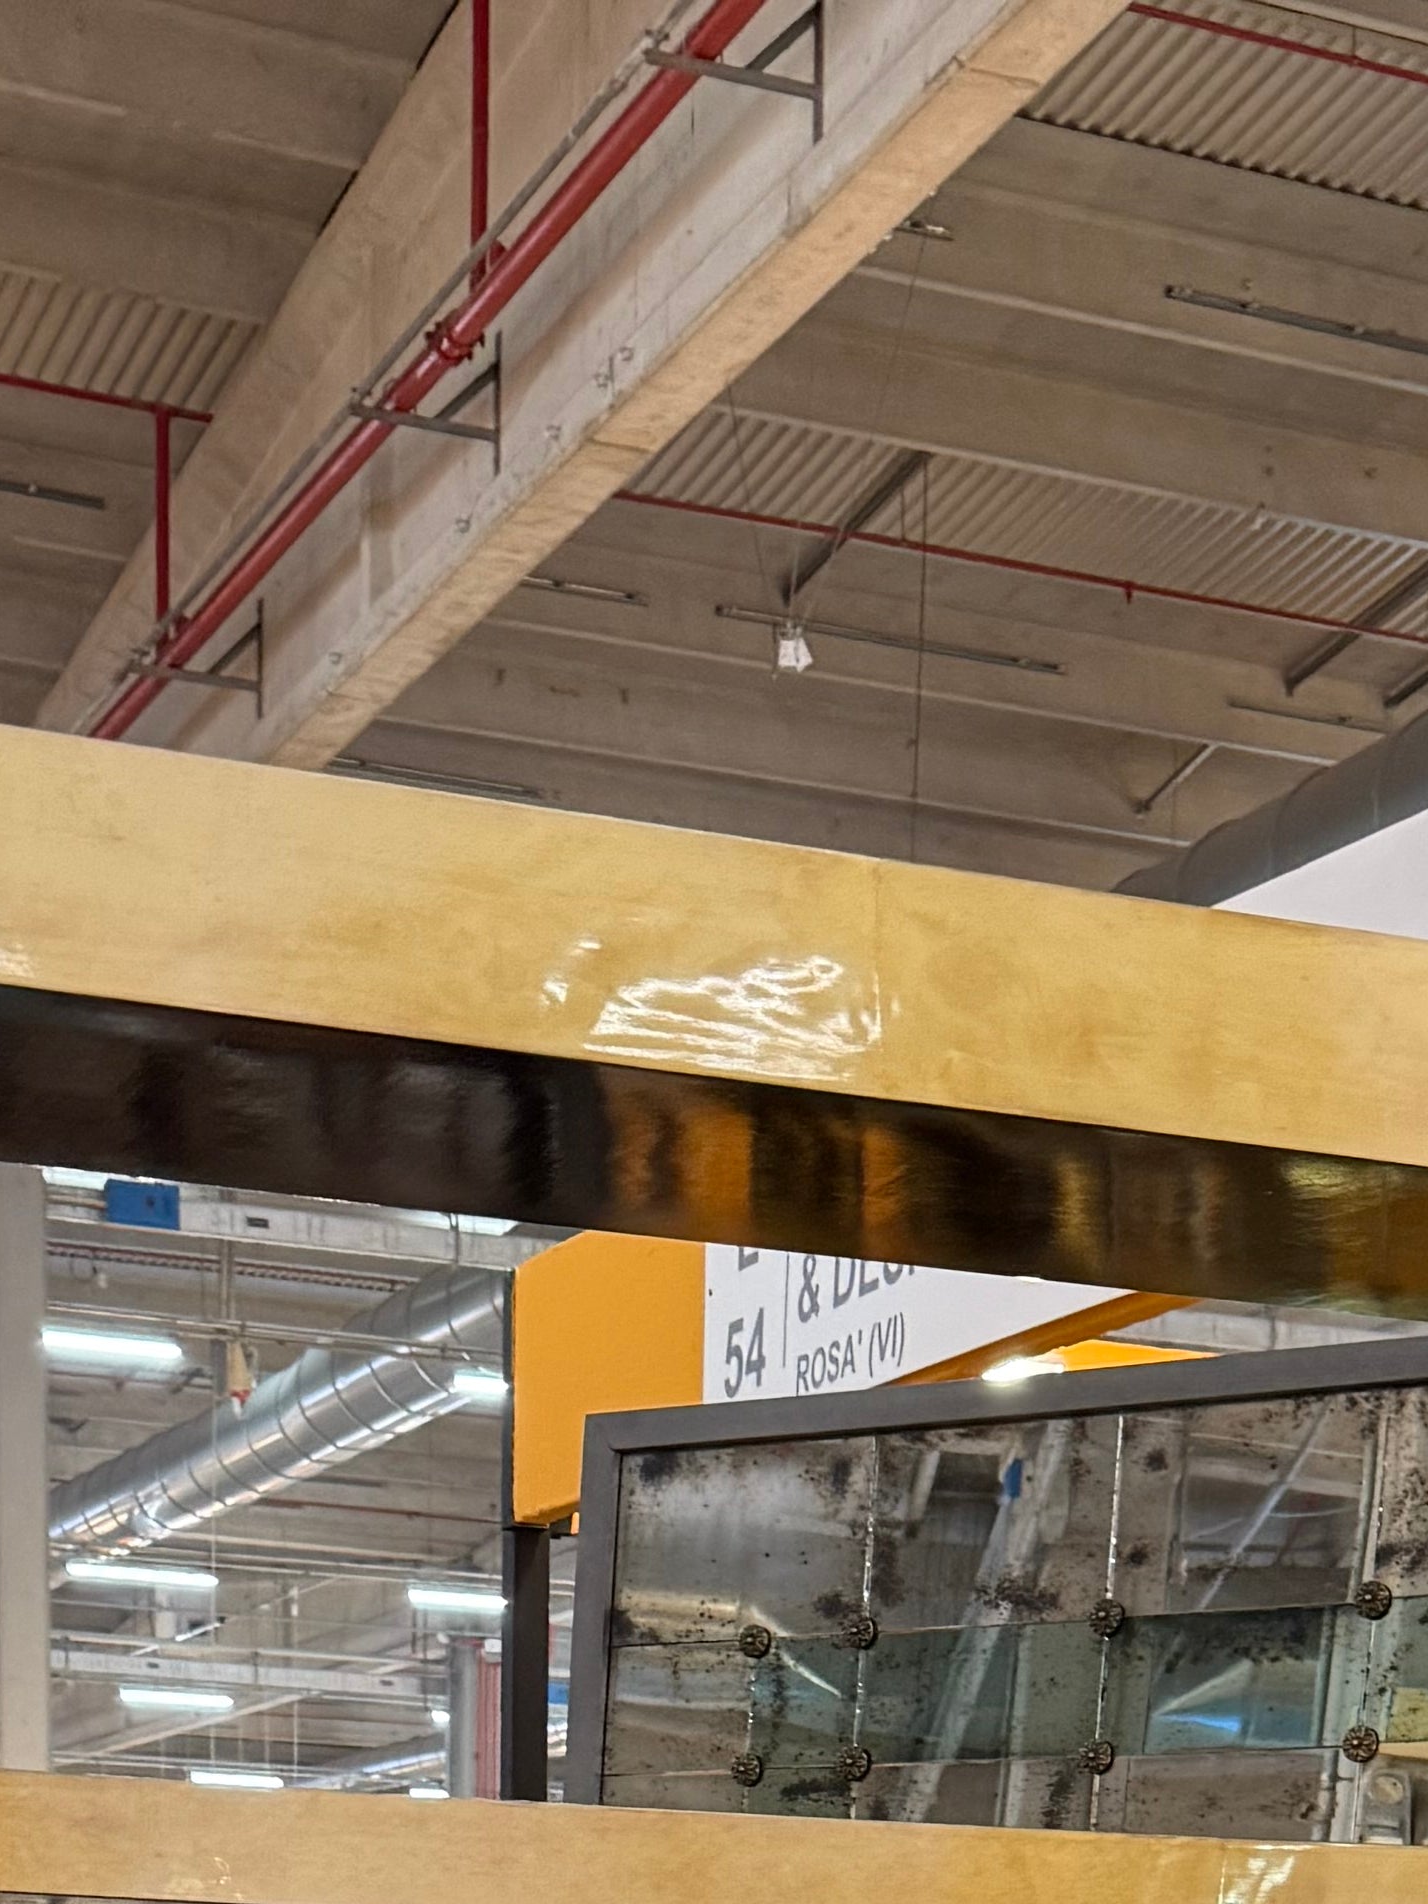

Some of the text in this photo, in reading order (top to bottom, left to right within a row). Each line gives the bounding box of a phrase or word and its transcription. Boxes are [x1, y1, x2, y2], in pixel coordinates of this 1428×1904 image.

[797, 1254, 820, 1323] &
[724, 1307, 765, 1398] 54
[795, 1311, 905, 1396] ROSA' (VI)
